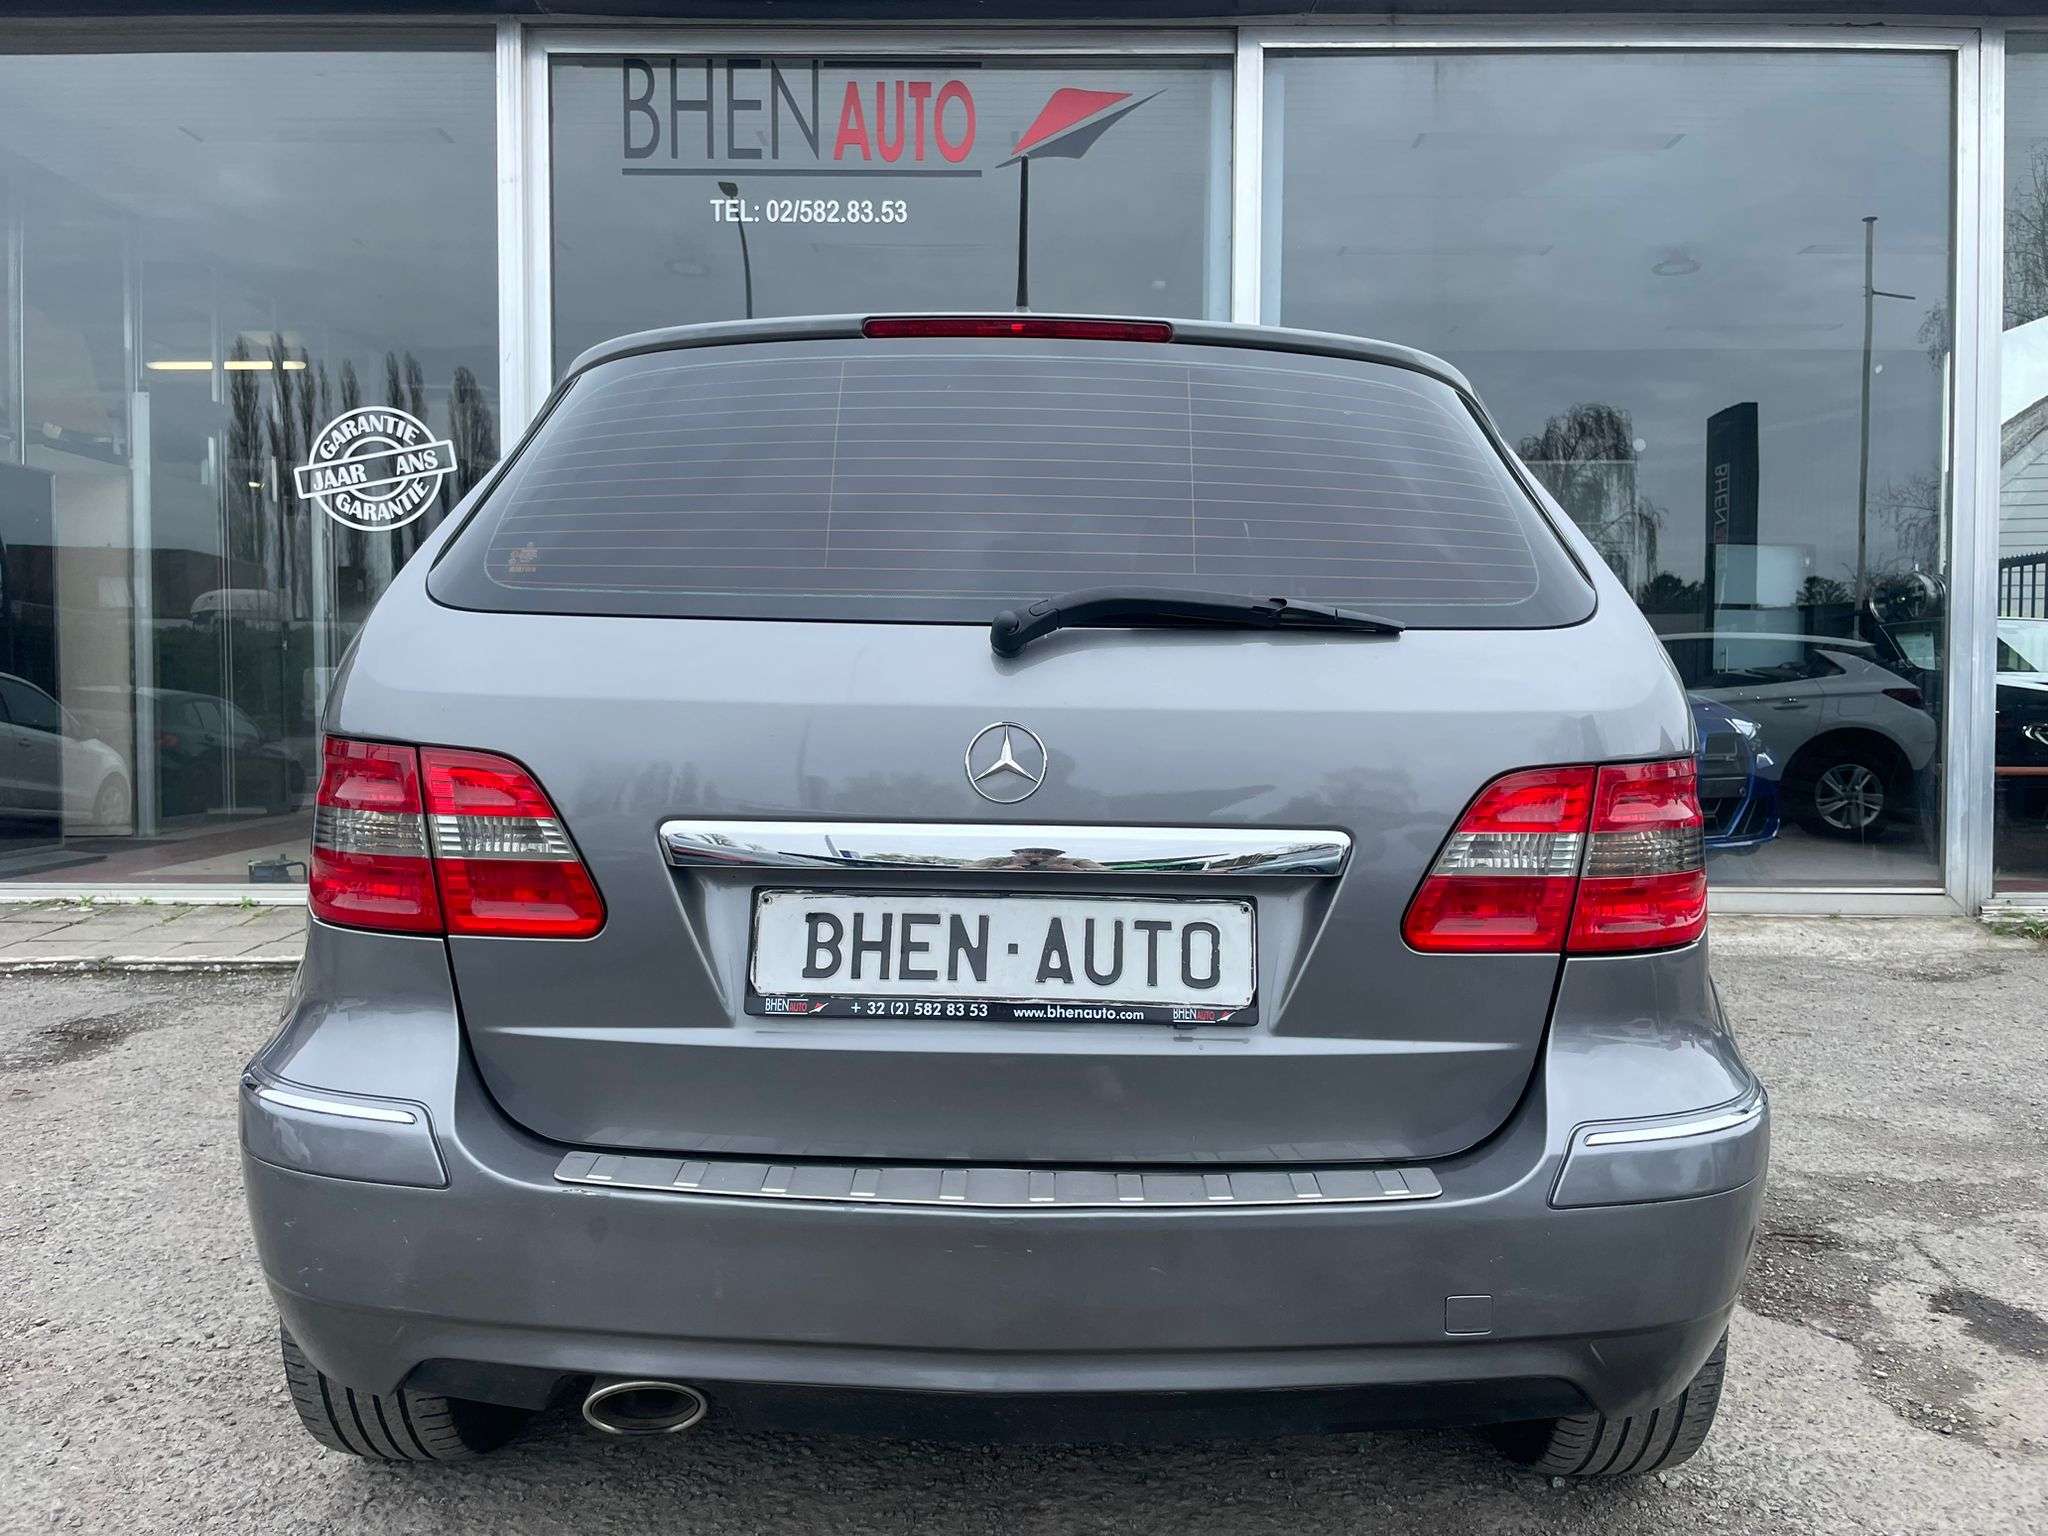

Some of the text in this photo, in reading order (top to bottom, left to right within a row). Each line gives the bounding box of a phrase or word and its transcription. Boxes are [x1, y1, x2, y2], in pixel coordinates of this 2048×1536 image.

[622, 59, 976, 163] BHEN AUTO
[710, 199, 908, 224] TEL: 02/582.83.53
[319, 415, 419, 460] GARANTIE
[313, 450, 439, 491] JAAR ANS
[335, 478, 429, 521] GARANTIE
[802, 912, 1221, 989] BHEN AUTO
[867, 1002, 884, 1015] 32
[890, 1002, 908, 1016] (2)
[914, 1002, 941, 1016] 582
[946, 1004, 964, 1016] 83
[969, 1004, 988, 1017] 53
[1013, 1005, 1144, 1020] www.bhenauto.com
